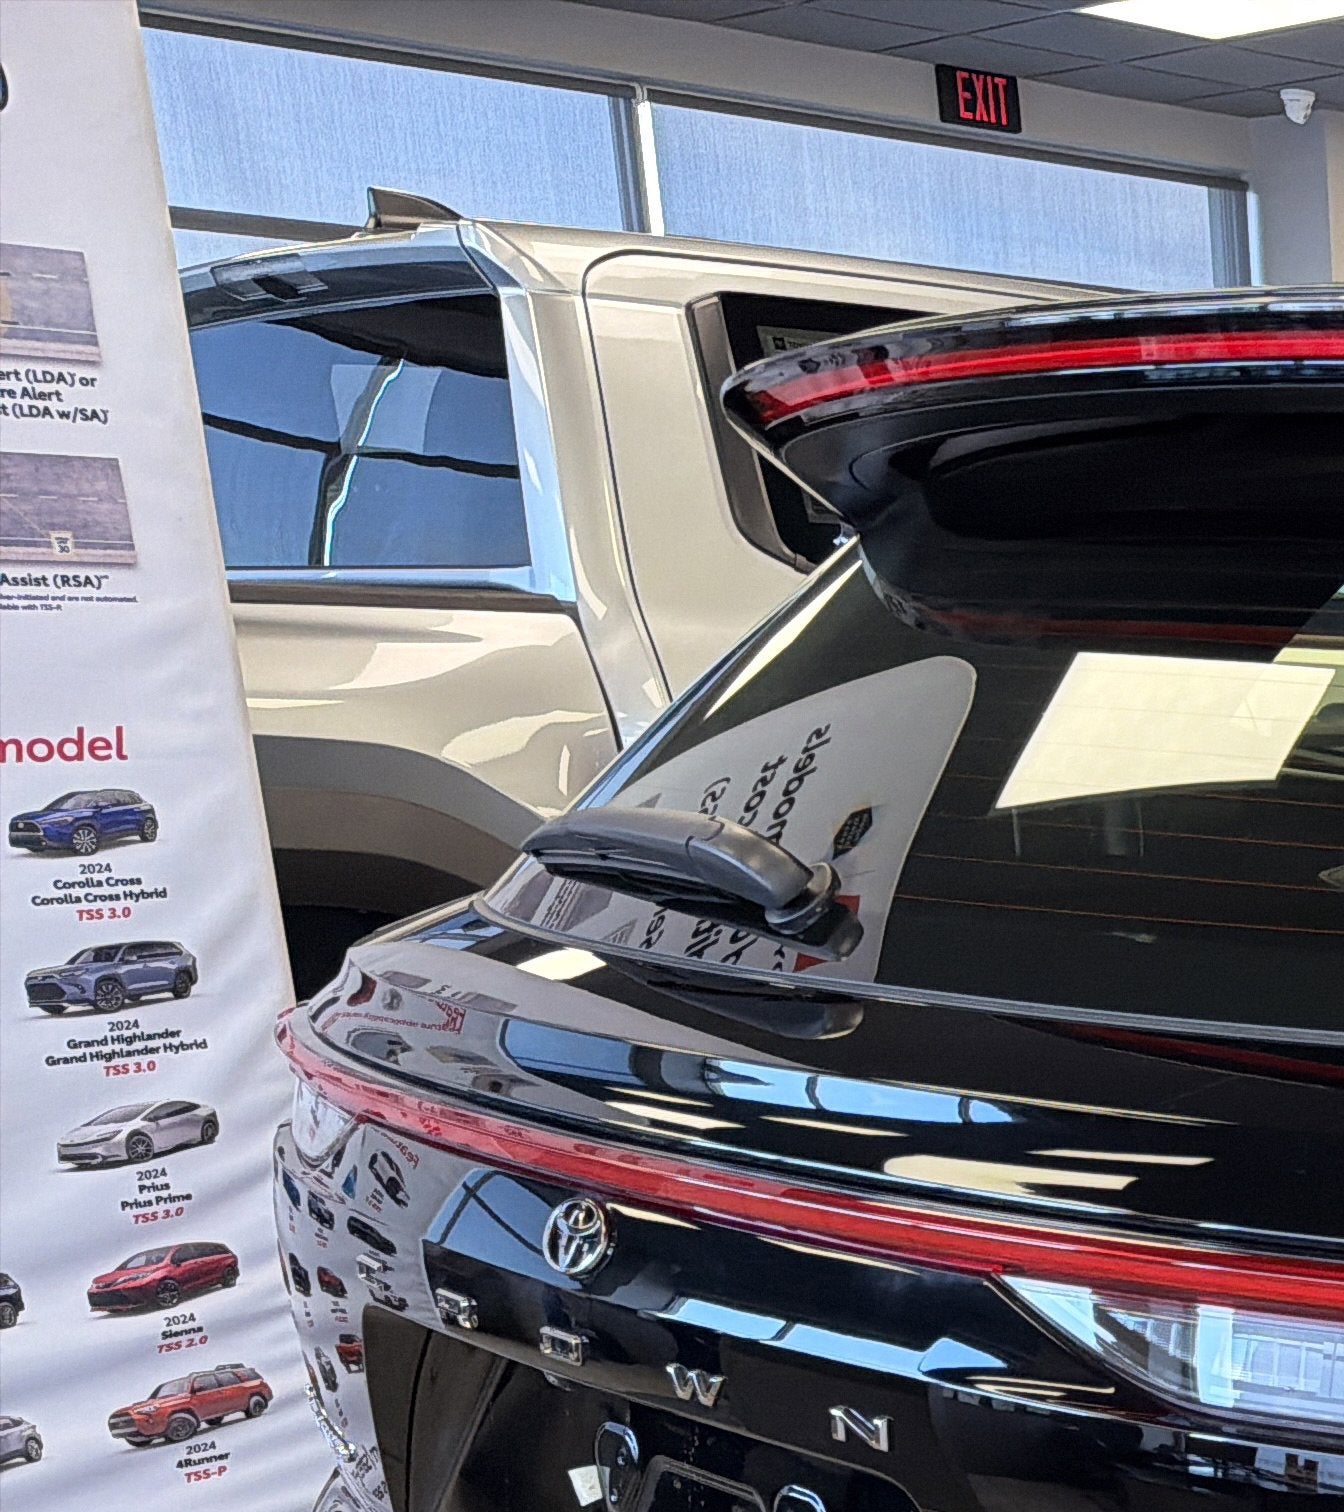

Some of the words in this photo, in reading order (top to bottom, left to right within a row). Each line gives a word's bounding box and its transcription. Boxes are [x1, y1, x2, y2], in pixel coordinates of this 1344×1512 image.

[956, 70, 1008, 126] EXIT
[0, 369, 22, 382] ert
[79, 376, 98, 387] or
[20, 386, 64, 402] Alert
[12, 403, 54, 419] (LDA
[79, 864, 112, 875] 2024
[53, 878, 104, 890] Corolla
[105, 876, 142, 887] Cross
[31, 893, 83, 906] Corolla
[84, 890, 121, 903] Cross
[123, 887, 168, 902] Hybrid
[76, 909, 106, 921] TSS
[107, 907, 132, 920] 3.0
[107, 1019, 140, 1032] 2024
[66, 1034, 108, 1050] Grand
[111, 1027, 182, 1047] Highlander
[44, 1052, 88, 1067] Grand
[89, 1044, 161, 1063] Highlander
[163, 1039, 208, 1055] Hybrid
[104, 1063, 131, 1077] TSS
[132, 1060, 157, 1074] 3.0
[136, 1167, 168, 1181] 2024
[138, 1181, 171, 1195] Prius
[121, 1197, 154, 1211] Prius
[155, 1191, 193, 1208] Prime
[132, 1211, 159, 1225] TSS
[160, 1206, 185, 1221] 3.0
[163, 1312, 197, 1327] 2024
[161, 1324, 204, 1340] Sienna
[156, 1341, 183, 1354] TSS
[183, 1335, 209, 1350] 2.0
[185, 1441, 217, 1455] 2024
[175, 1450, 232, 1470] 4Runner
[183, 1465, 228, 1484] TSS-P
